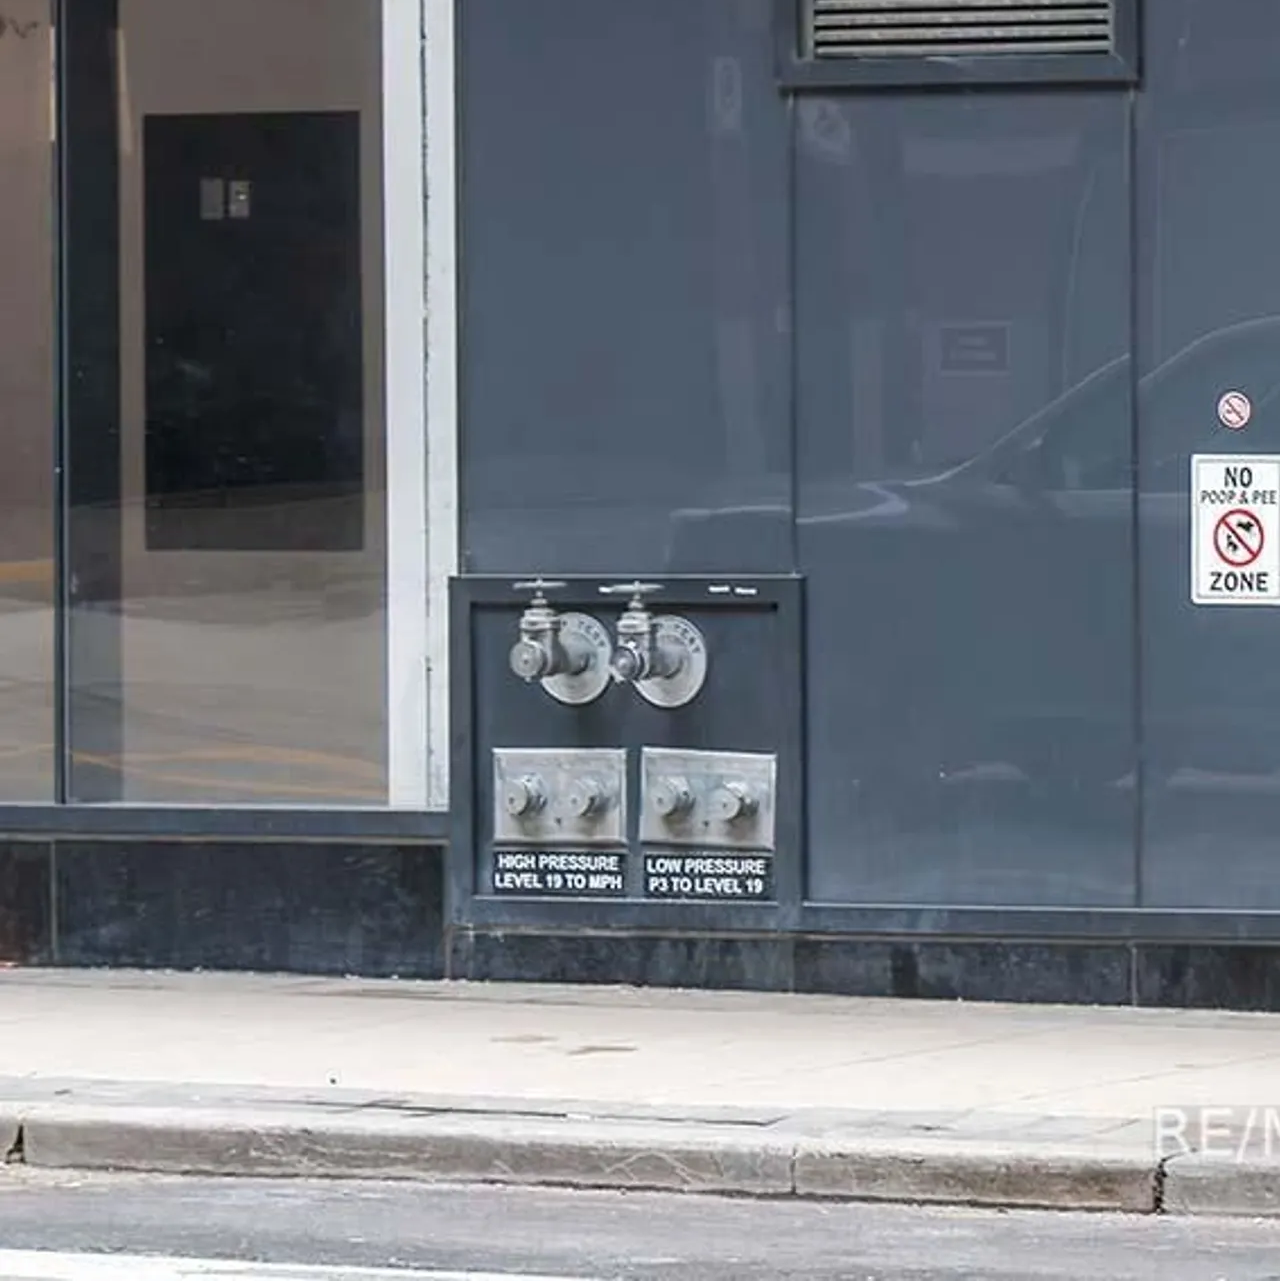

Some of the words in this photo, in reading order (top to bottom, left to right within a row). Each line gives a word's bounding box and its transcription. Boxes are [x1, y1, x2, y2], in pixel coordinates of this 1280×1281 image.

[1224, 467, 1253, 488] NO
[1200, 490, 1236, 505] POOP
[1239, 490, 1249, 504] &
[1251, 490, 1277, 505] PEE
[1209, 571, 1269, 592] ZONE
[498, 853, 536, 870] HIGH
[539, 853, 619, 871] PRESSURE
[646, 858, 683, 873] LOW
[684, 858, 767, 875] PRESSURE
[494, 872, 543, 889] LEVEL
[545, 873, 563, 889] 19
[564, 873, 587, 890] TO
[588, 873, 622, 890] MPH
[649, 877, 668, 892] P3
[670, 877, 692, 892] TO
[694, 877, 743, 894] LEVEL
[745, 878, 763, 894] 19
